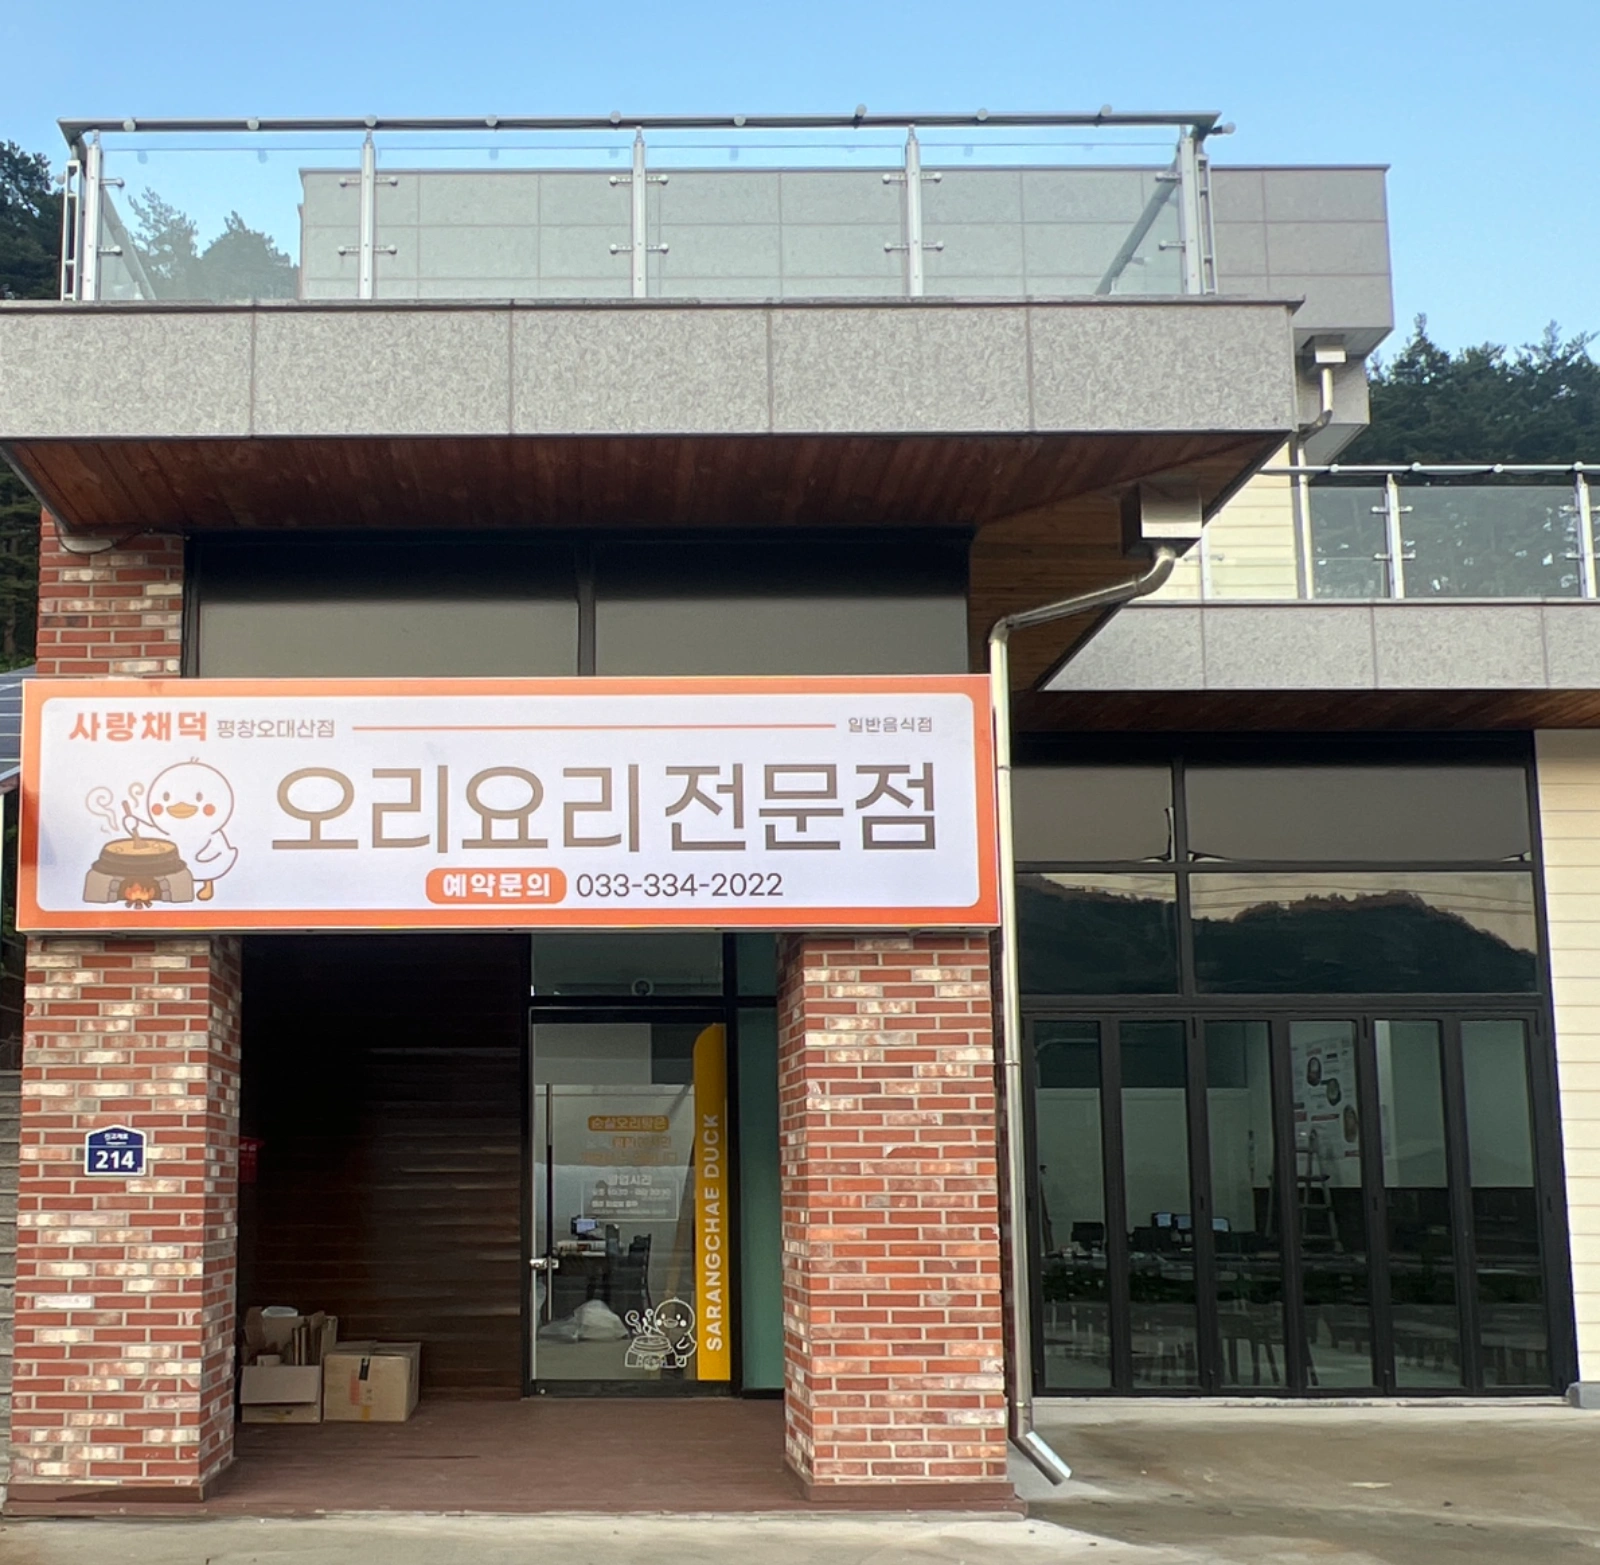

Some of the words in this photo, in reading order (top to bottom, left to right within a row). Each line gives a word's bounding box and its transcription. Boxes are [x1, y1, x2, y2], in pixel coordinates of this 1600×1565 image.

[69, 711, 207, 741] 사랑채덕
[216, 718, 336, 739] 평창오대산점
[848, 716, 933, 733] 일반음식점
[442, 872, 551, 898] 예약문의
[576, 873, 784, 897] 033-334-2022
[95, 1150, 135, 1169] 214
[703, 1113, 720, 1180] DUCK
[702, 1186, 723, 1352] SARANGCHAE
